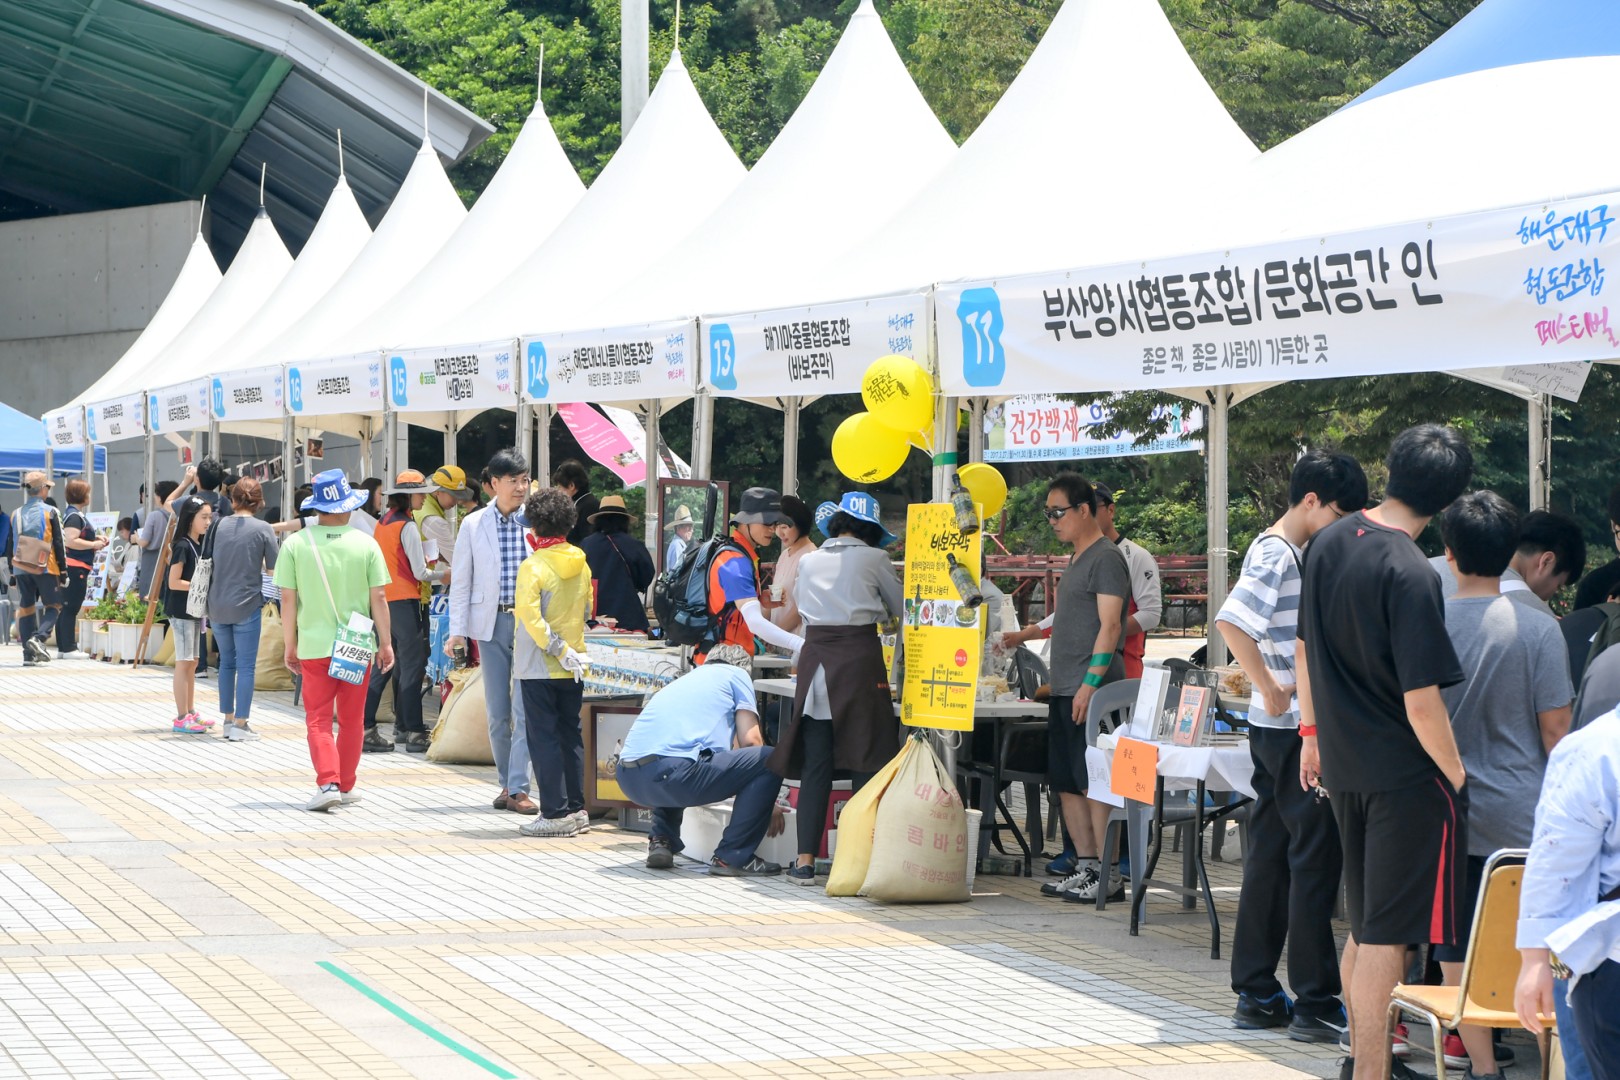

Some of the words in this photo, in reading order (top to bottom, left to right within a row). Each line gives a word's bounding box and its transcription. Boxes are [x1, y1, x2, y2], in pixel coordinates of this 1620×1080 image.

[1516, 205, 1615, 251] 해운대구
[1043, 246, 1398, 341] 부산양서협동조합/문화공간
[1401, 239, 1443, 306] 인
[1523, 258, 1605, 305] 협동조합
[965, 310, 995, 369] 11
[1535, 306, 1619, 348] 페스티벌
[530, 355, 545, 387] 14
[714, 339, 731, 377] 13
[788, 352, 834, 382] (바보주막)
[1142, 346, 1167, 375] 좋은
[1170, 345, 1187, 373] 책,
[1192, 342, 1218, 372] 좋은
[1221, 338, 1262, 369] 사람이
[1265, 334, 1309, 366] 가득한
[1313, 334, 1328, 364] 곳
[214, 388, 222, 410] 17
[290, 378, 300, 402] 16
[393, 368, 406, 396] 15
[1010, 406, 1079, 445] 건강백세
[931, 530, 970, 552] 바보주막
